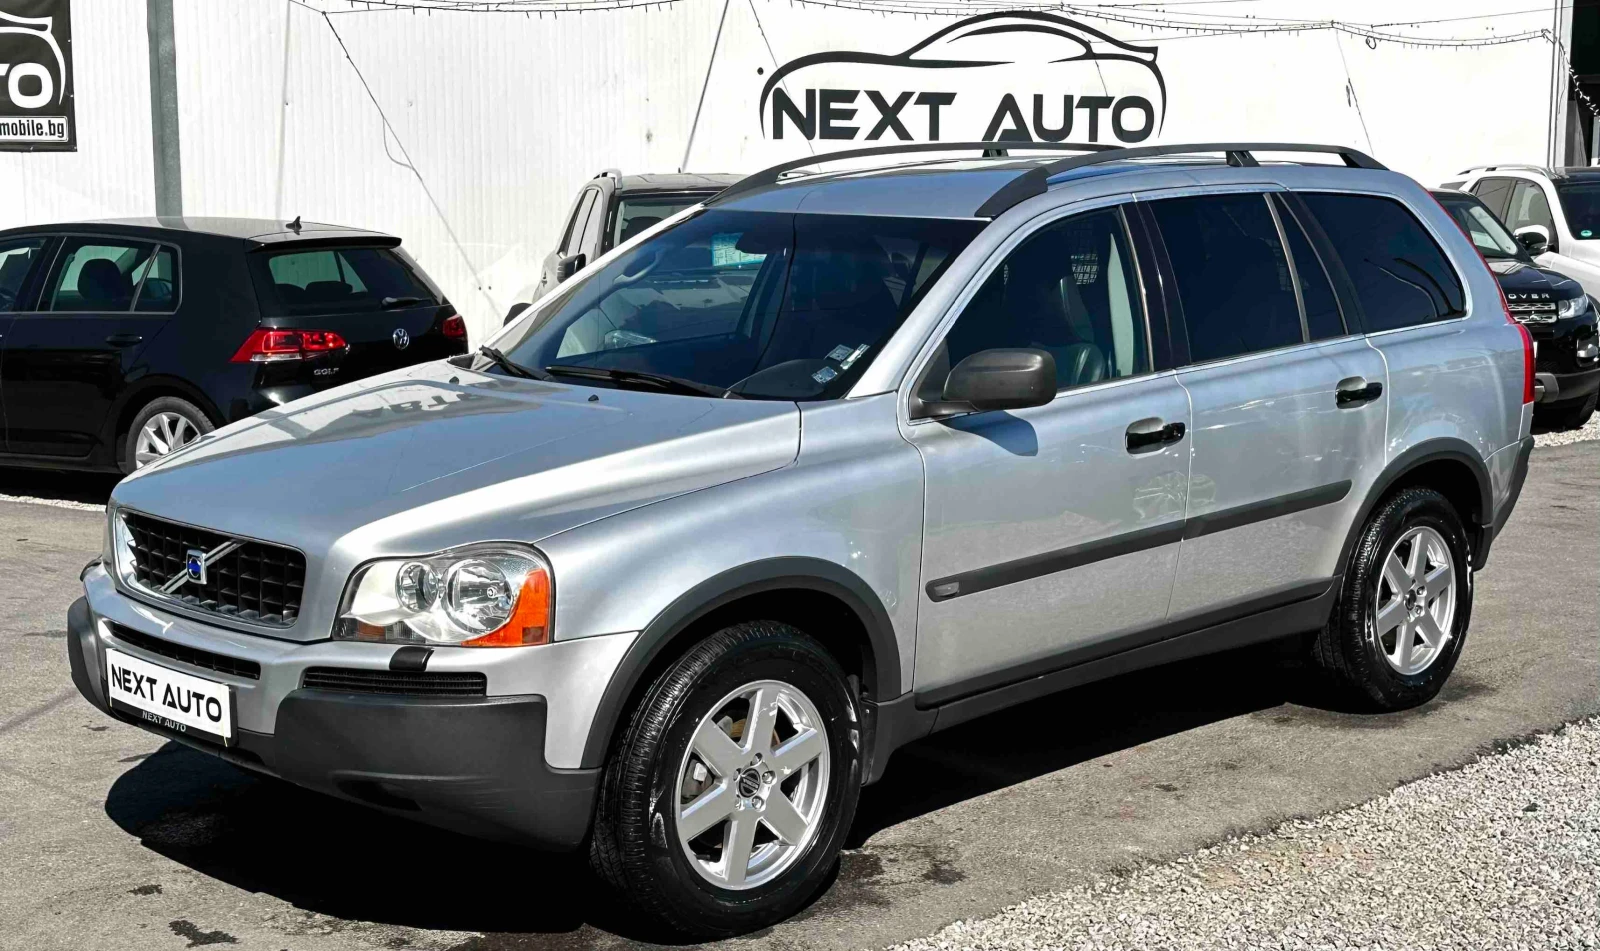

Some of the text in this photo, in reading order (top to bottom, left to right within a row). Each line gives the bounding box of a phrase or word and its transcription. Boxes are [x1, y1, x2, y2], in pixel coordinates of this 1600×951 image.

[773, 87, 1154, 143] NEXT AUTO
[314, 368, 339, 376] GOLF
[111, 664, 222, 722] NEXT AUTO
[142, 711, 187, 732] NEXT AUTO
